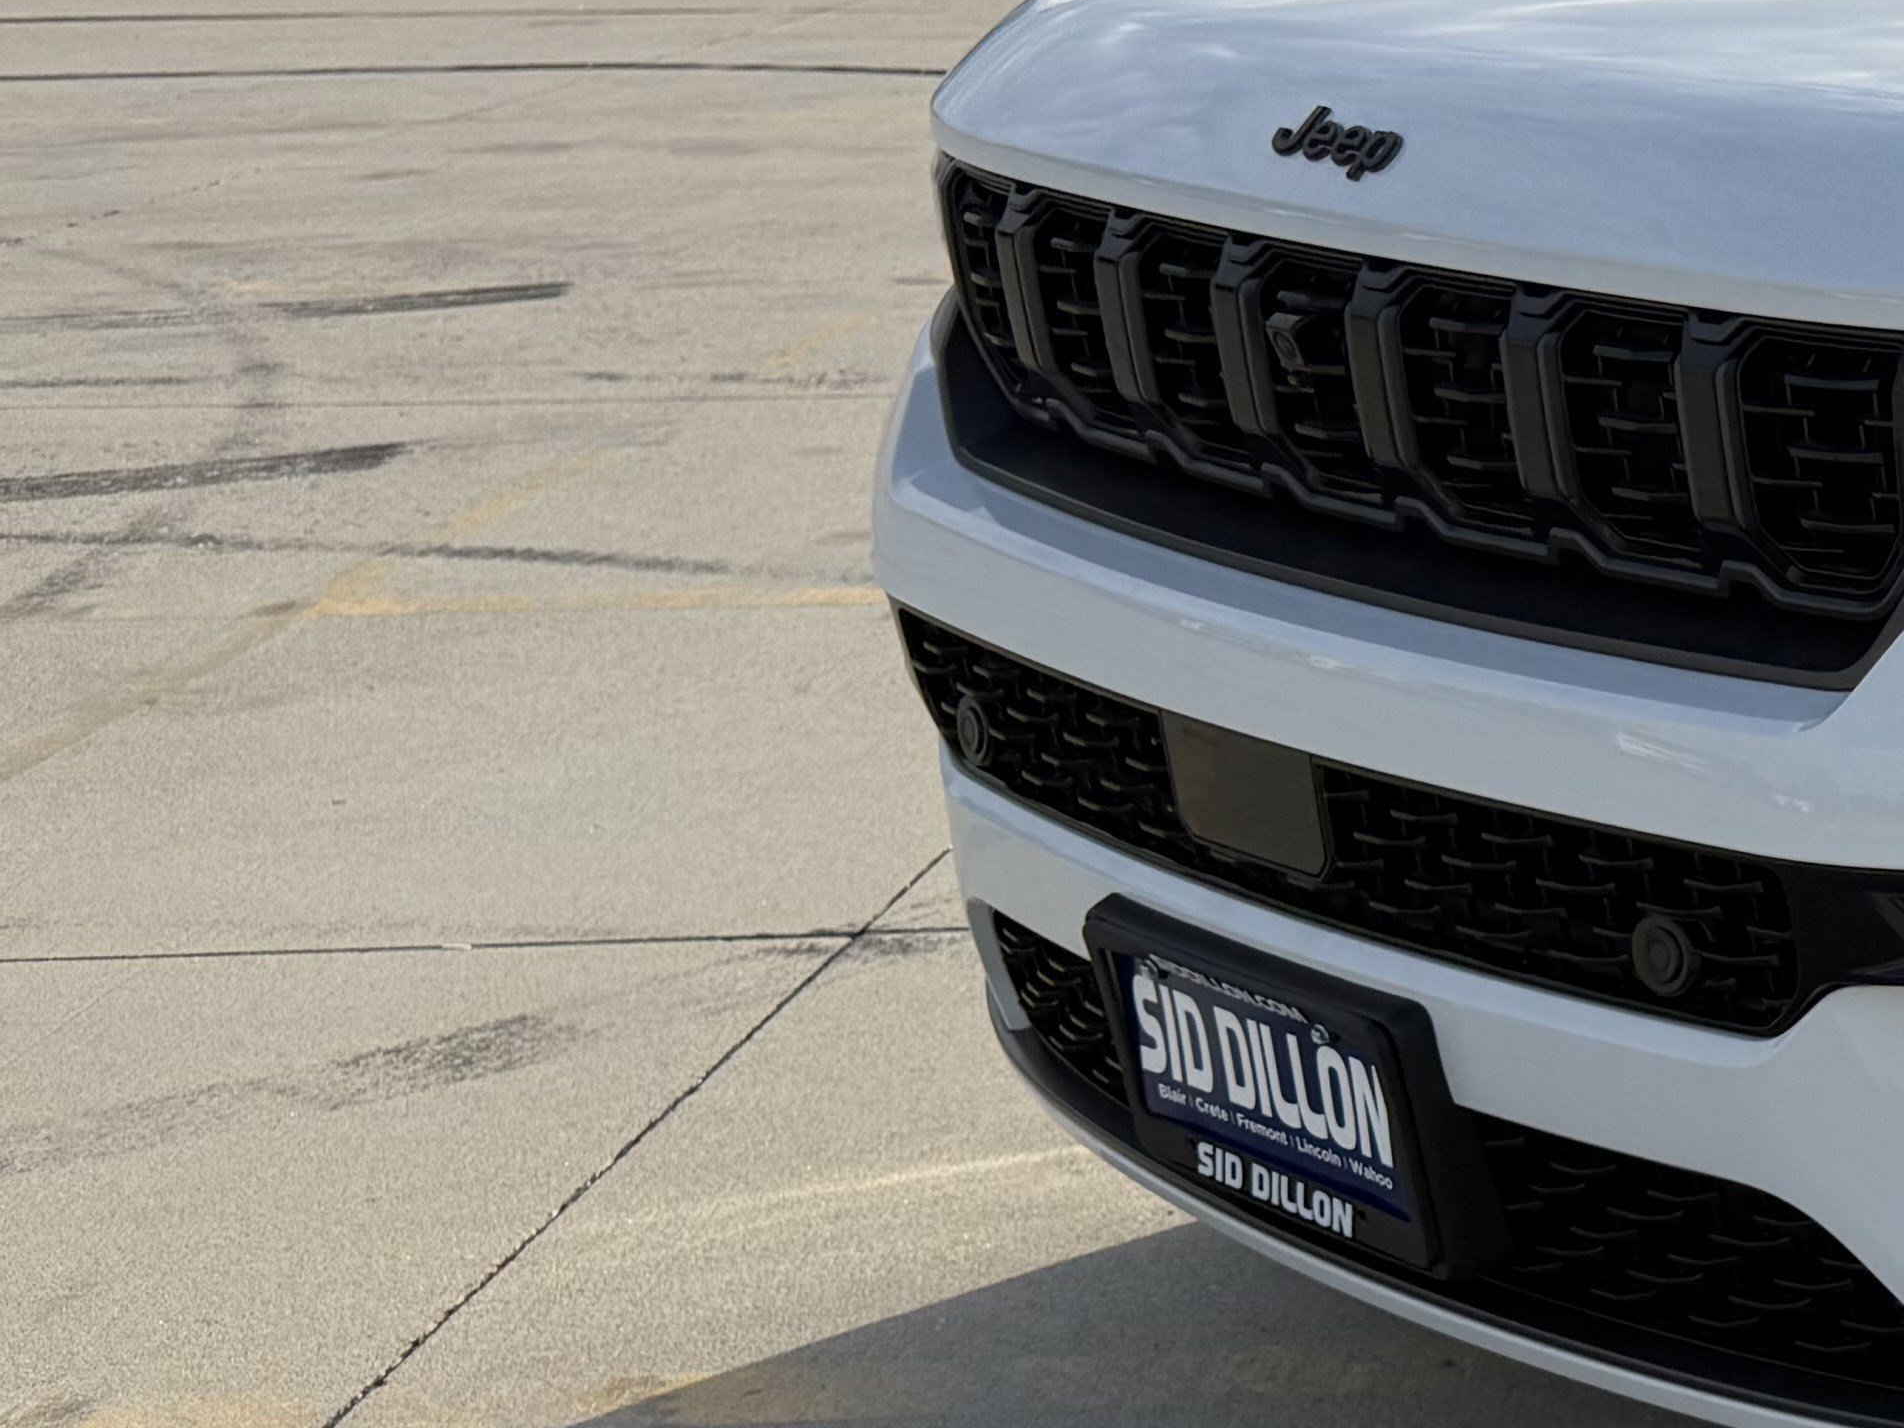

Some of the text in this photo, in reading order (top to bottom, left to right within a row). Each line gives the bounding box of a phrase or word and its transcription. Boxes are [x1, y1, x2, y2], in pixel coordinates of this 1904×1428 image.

[1272, 105, 1404, 182] Jeep
[1132, 972, 1394, 1168] SID DILLON
[1158, 1083, 1394, 1190] Blair Crete Fremont Lincoln Wahoo
[1196, 1142, 1354, 1239] SID DILLON
